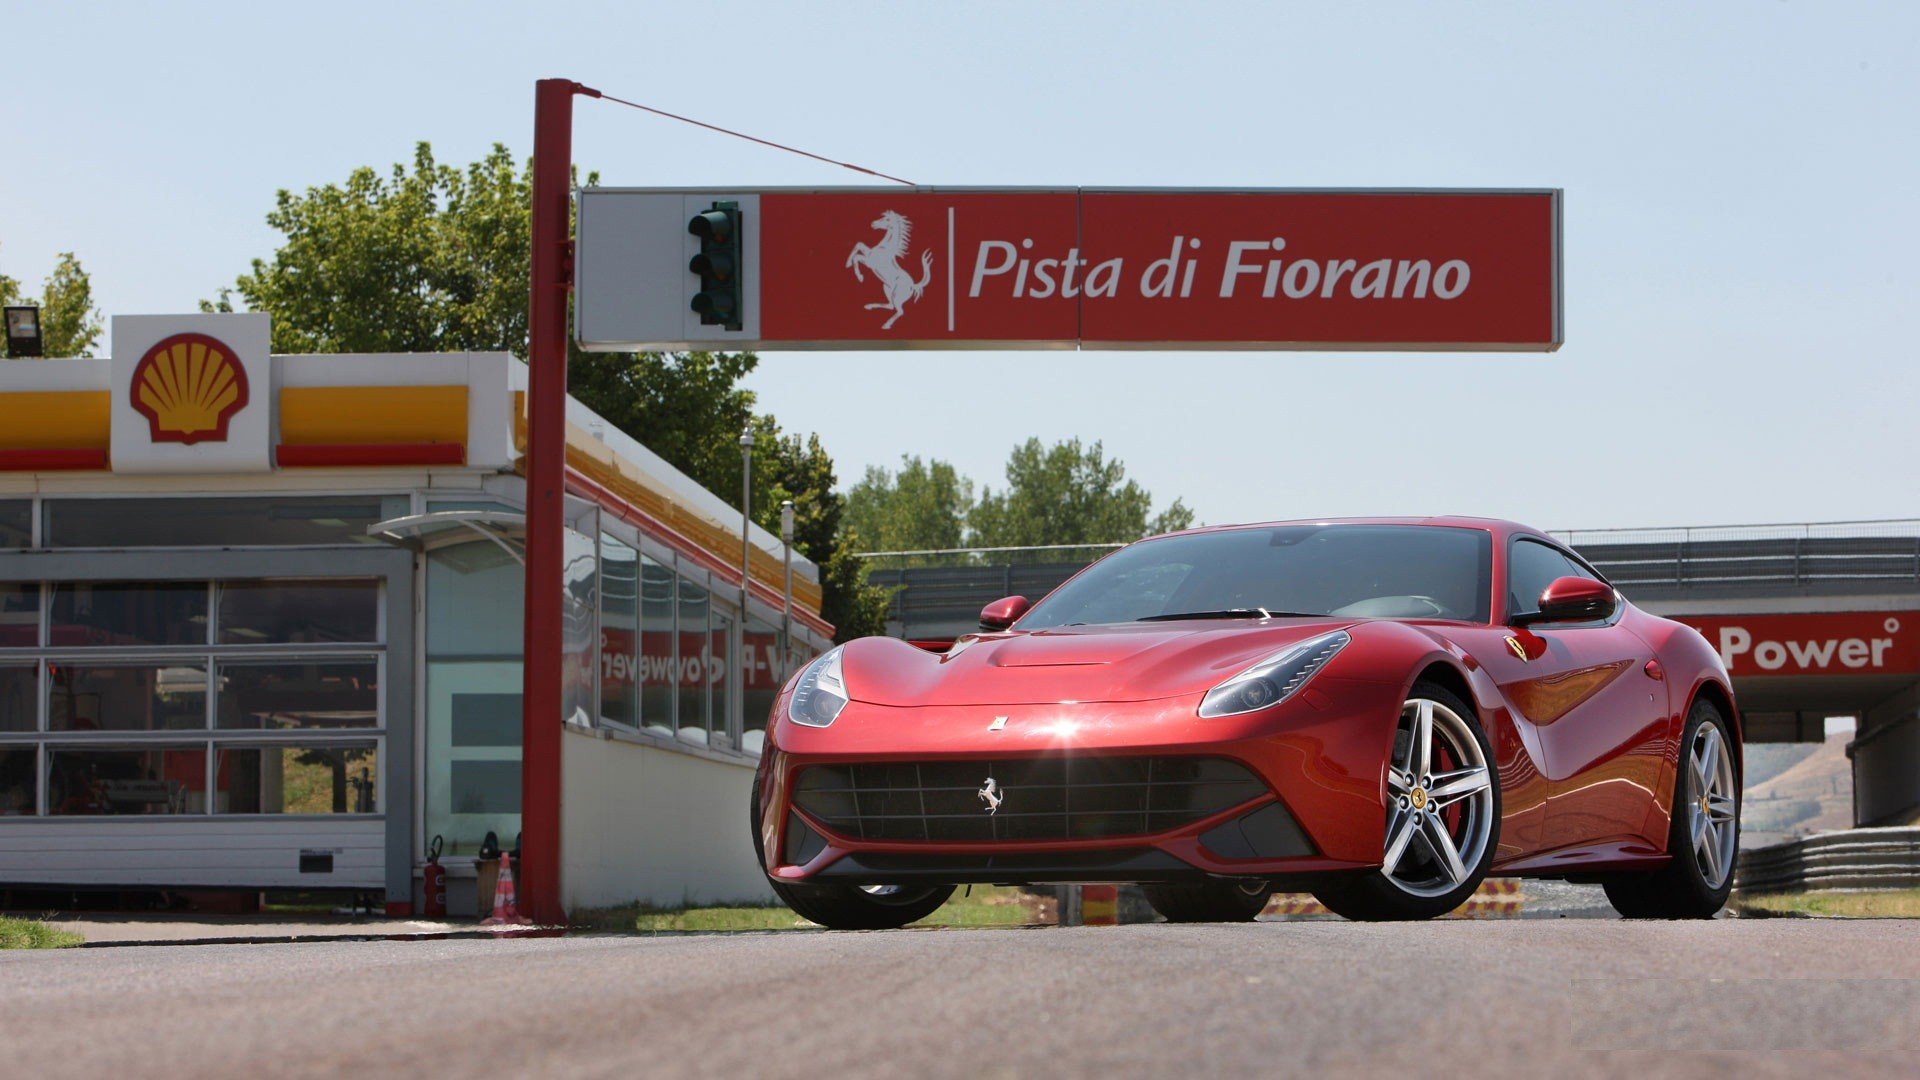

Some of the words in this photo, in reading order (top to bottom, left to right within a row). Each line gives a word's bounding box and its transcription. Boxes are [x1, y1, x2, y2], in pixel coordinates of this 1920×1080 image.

[968, 238, 1124, 299] Pista
[1139, 235, 1202, 298] di
[1219, 236, 1472, 300] Fiorano
[1697, 626, 1894, 670] Power
